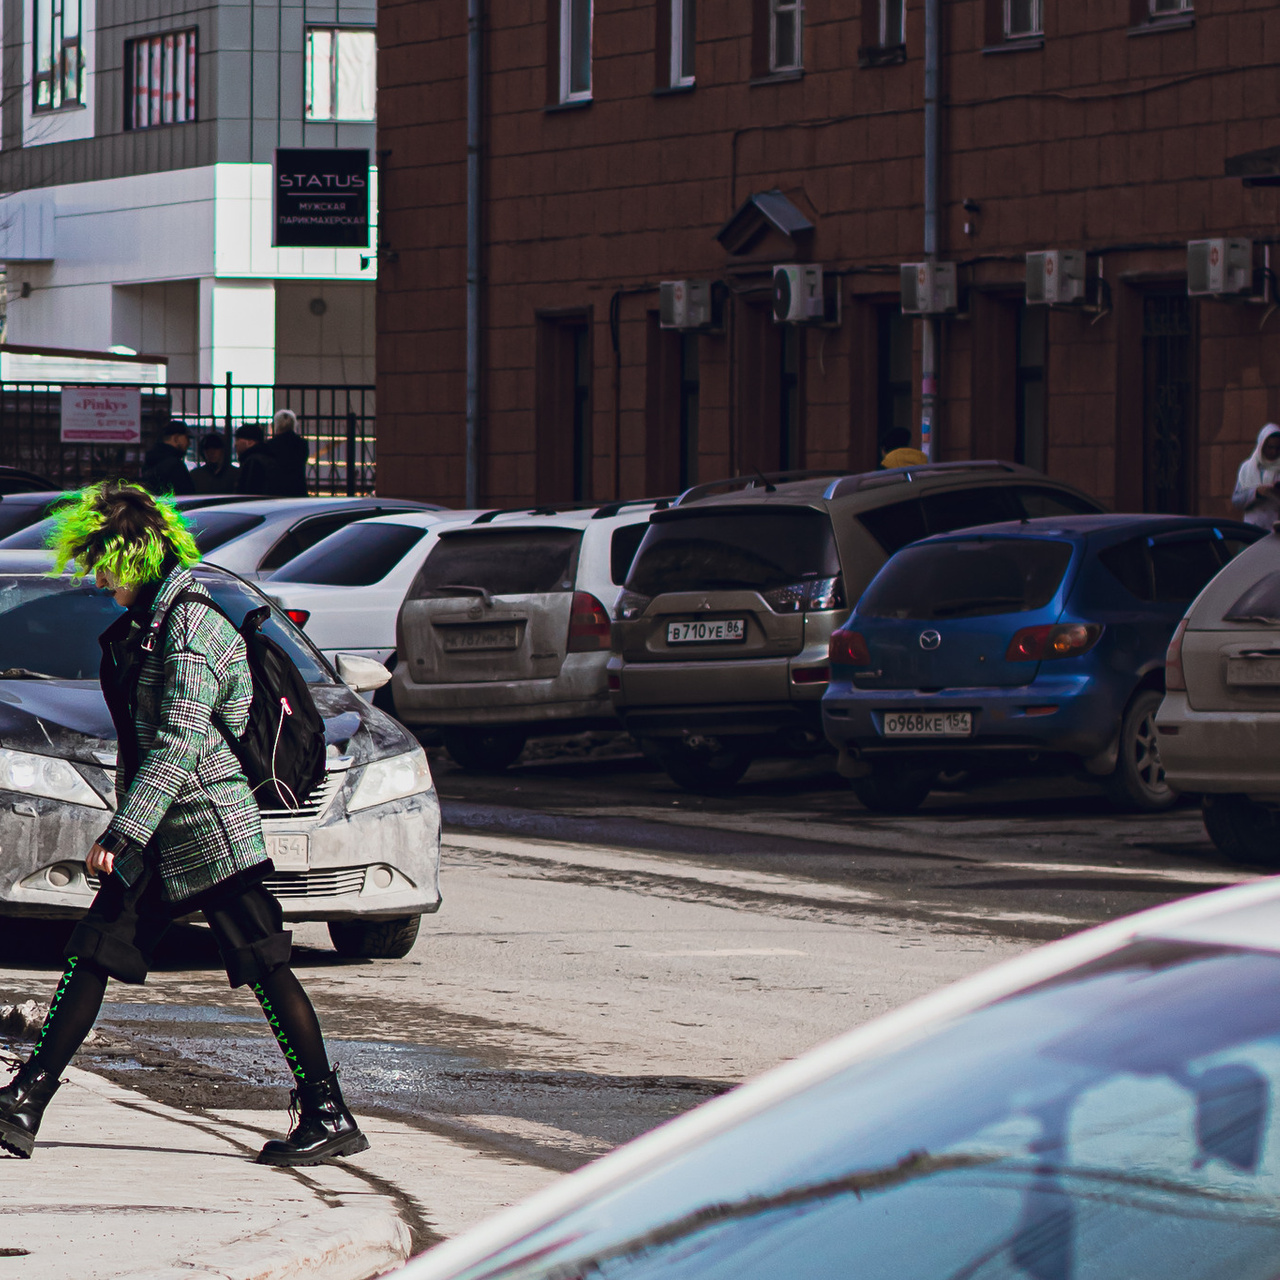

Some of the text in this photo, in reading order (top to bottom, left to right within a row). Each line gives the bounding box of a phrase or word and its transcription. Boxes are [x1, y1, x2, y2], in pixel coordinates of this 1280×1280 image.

[279, 174, 366, 188] STATUS
[298, 202, 347, 211] МУЖСКАЯ
[279, 215, 366, 225] ПАРИКМАХЕРСКАЯ
[672, 620, 740, 640] В710УЕ 86
[888, 713, 969, 732] О968КЕ 154
[270, 837, 301, 856] 154
